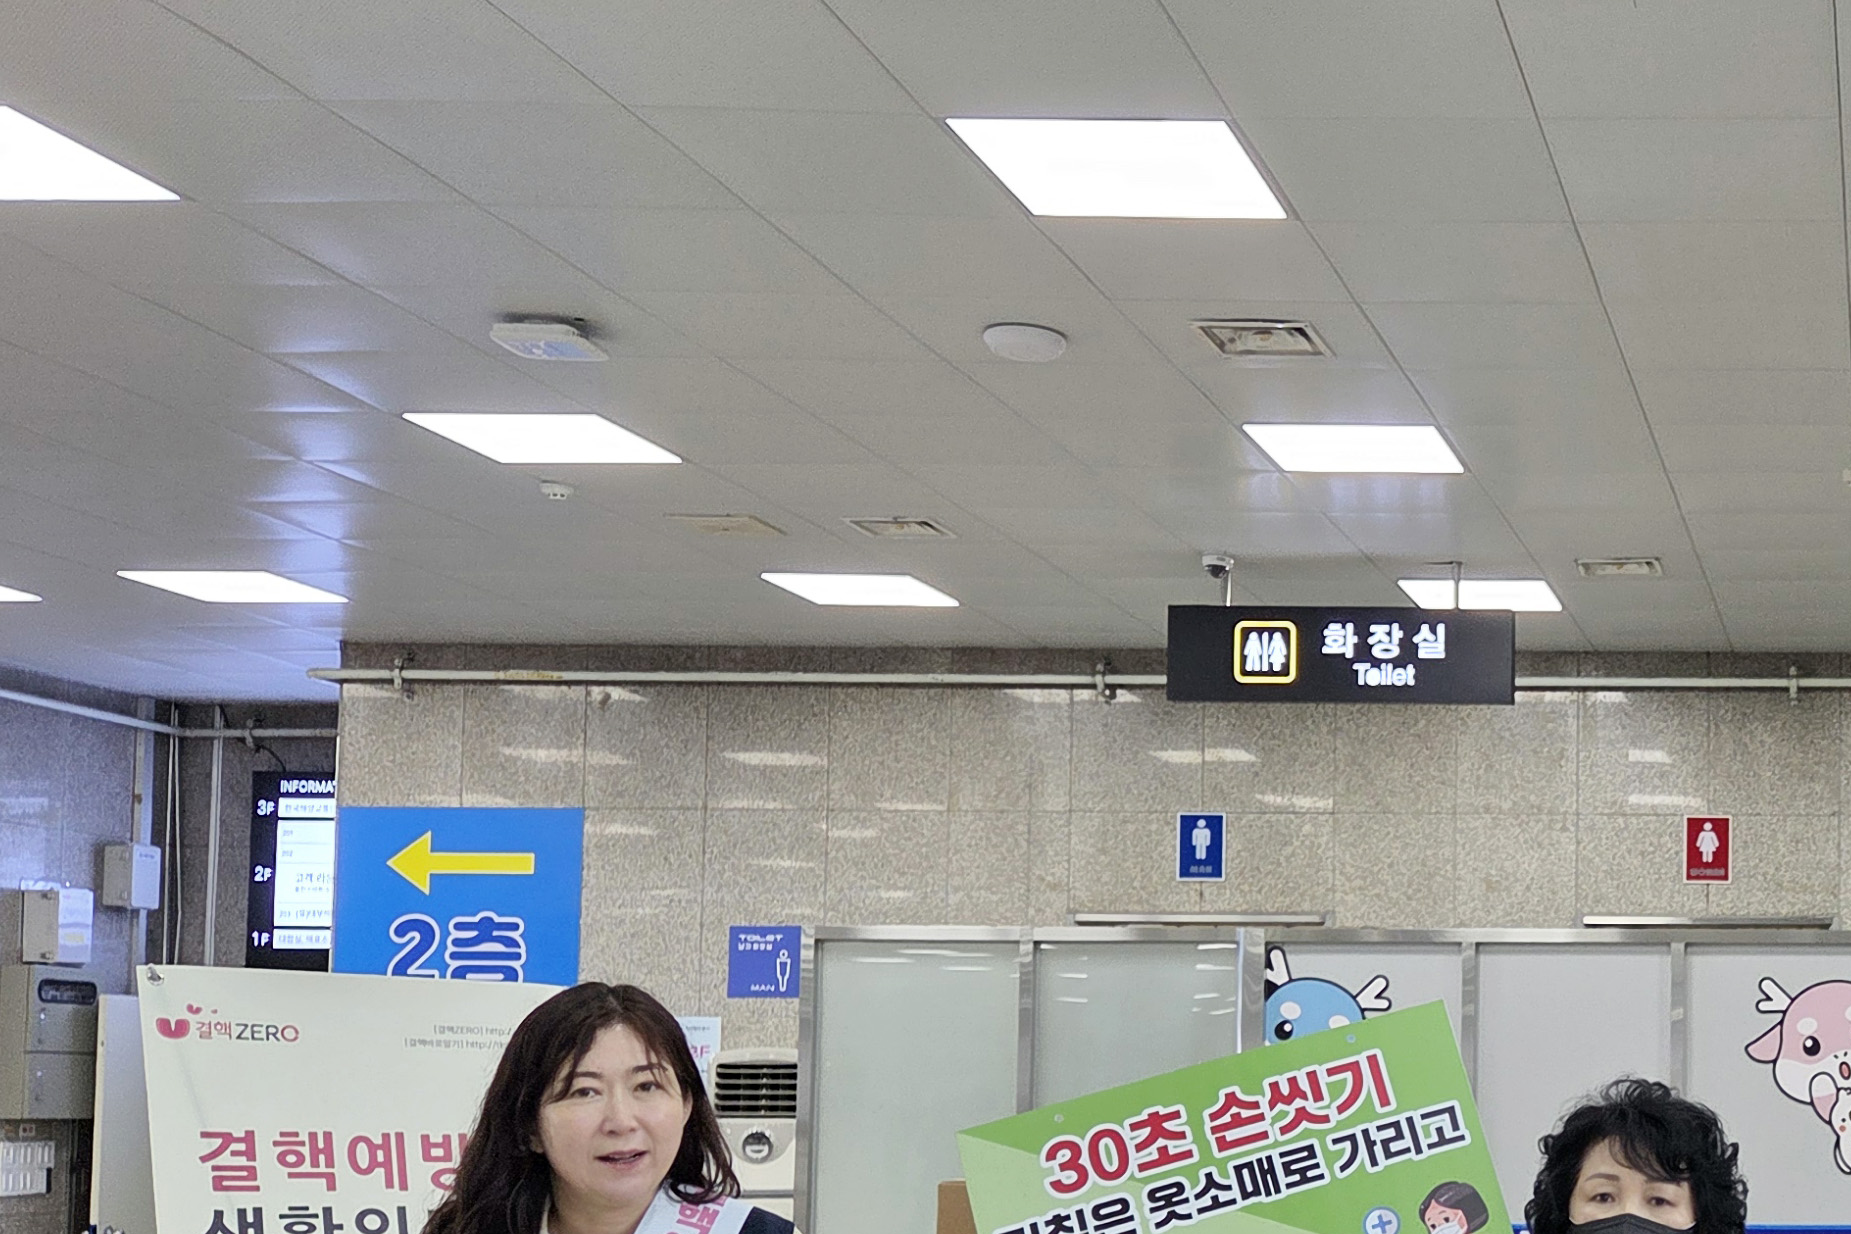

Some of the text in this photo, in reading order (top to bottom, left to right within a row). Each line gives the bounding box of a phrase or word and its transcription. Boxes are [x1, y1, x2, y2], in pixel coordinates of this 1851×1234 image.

[1321, 621, 1448, 659] 화장실
[1352, 662, 1417, 687] Toilet
[257, 799, 276, 816] 3F
[253, 865, 273, 882] 2F
[252, 930, 270, 947] 1F
[387, 911, 527, 985] 2층
[750, 983, 776, 993] MAN
[195, 1019, 301, 1044] 결핵ZERO
[1044, 1053, 1393, 1194] 30초 손씻기
[1146, 1147, 1328, 1228] 옷소매로
[1331, 1104, 1467, 1174] 가리고
